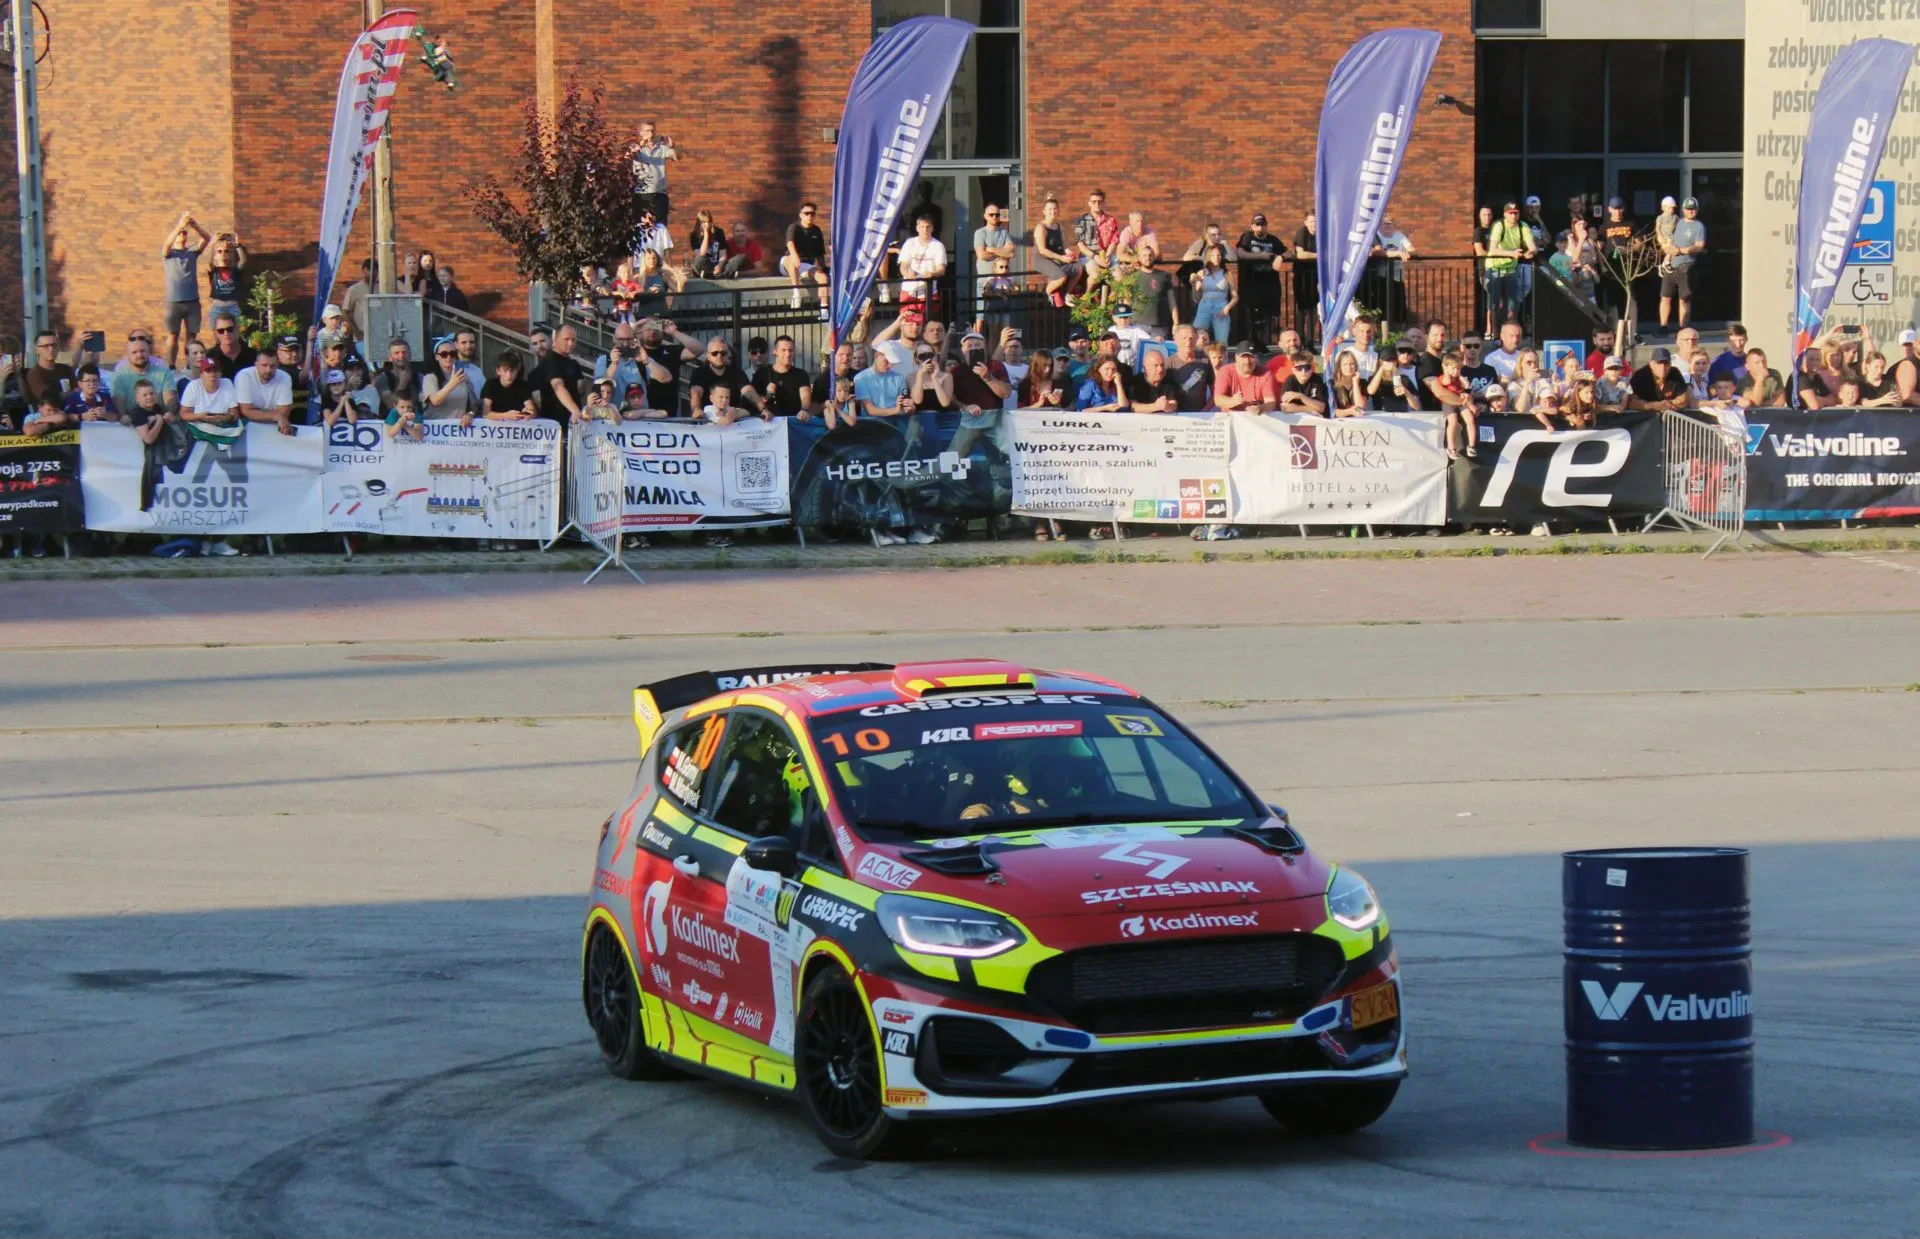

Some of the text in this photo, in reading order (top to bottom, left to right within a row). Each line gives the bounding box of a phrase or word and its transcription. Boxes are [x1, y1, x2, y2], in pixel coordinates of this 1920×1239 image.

[480, 424, 557, 441] SYSTEMÓW
[1322, 427, 1391, 447] MŁYN
[1015, 442, 1134, 454] Wypożyczamy:
[27, 461, 61, 473] 2753
[329, 453, 384, 465] aquer
[1106, 459, 1157, 468] szalunki
[1323, 450, 1390, 472] JACKA
[826, 459, 938, 481] HÖGERT
[1023, 473, 1069, 481] koparki
[1291, 482, 1391, 493] HOTEL & SPA
[1785, 474, 1809, 487] THE
[1813, 473, 1874, 487] ORIGINAL
[153, 486, 248, 508] MOSUR
[1024, 486, 1134, 497] sprzęt budowlany
[1025, 499, 1126, 510] elektronarzędzia
[152, 511, 248, 526] WARSZTAT
[691, 713, 727, 771] 10
[821, 727, 892, 757] 10
[860, 856, 914, 888] ACME
[1080, 880, 1261, 905] SZCZĘŚNIAK
[1149, 912, 1259, 932] Kadimex
[671, 904, 741, 964] Kadimex
